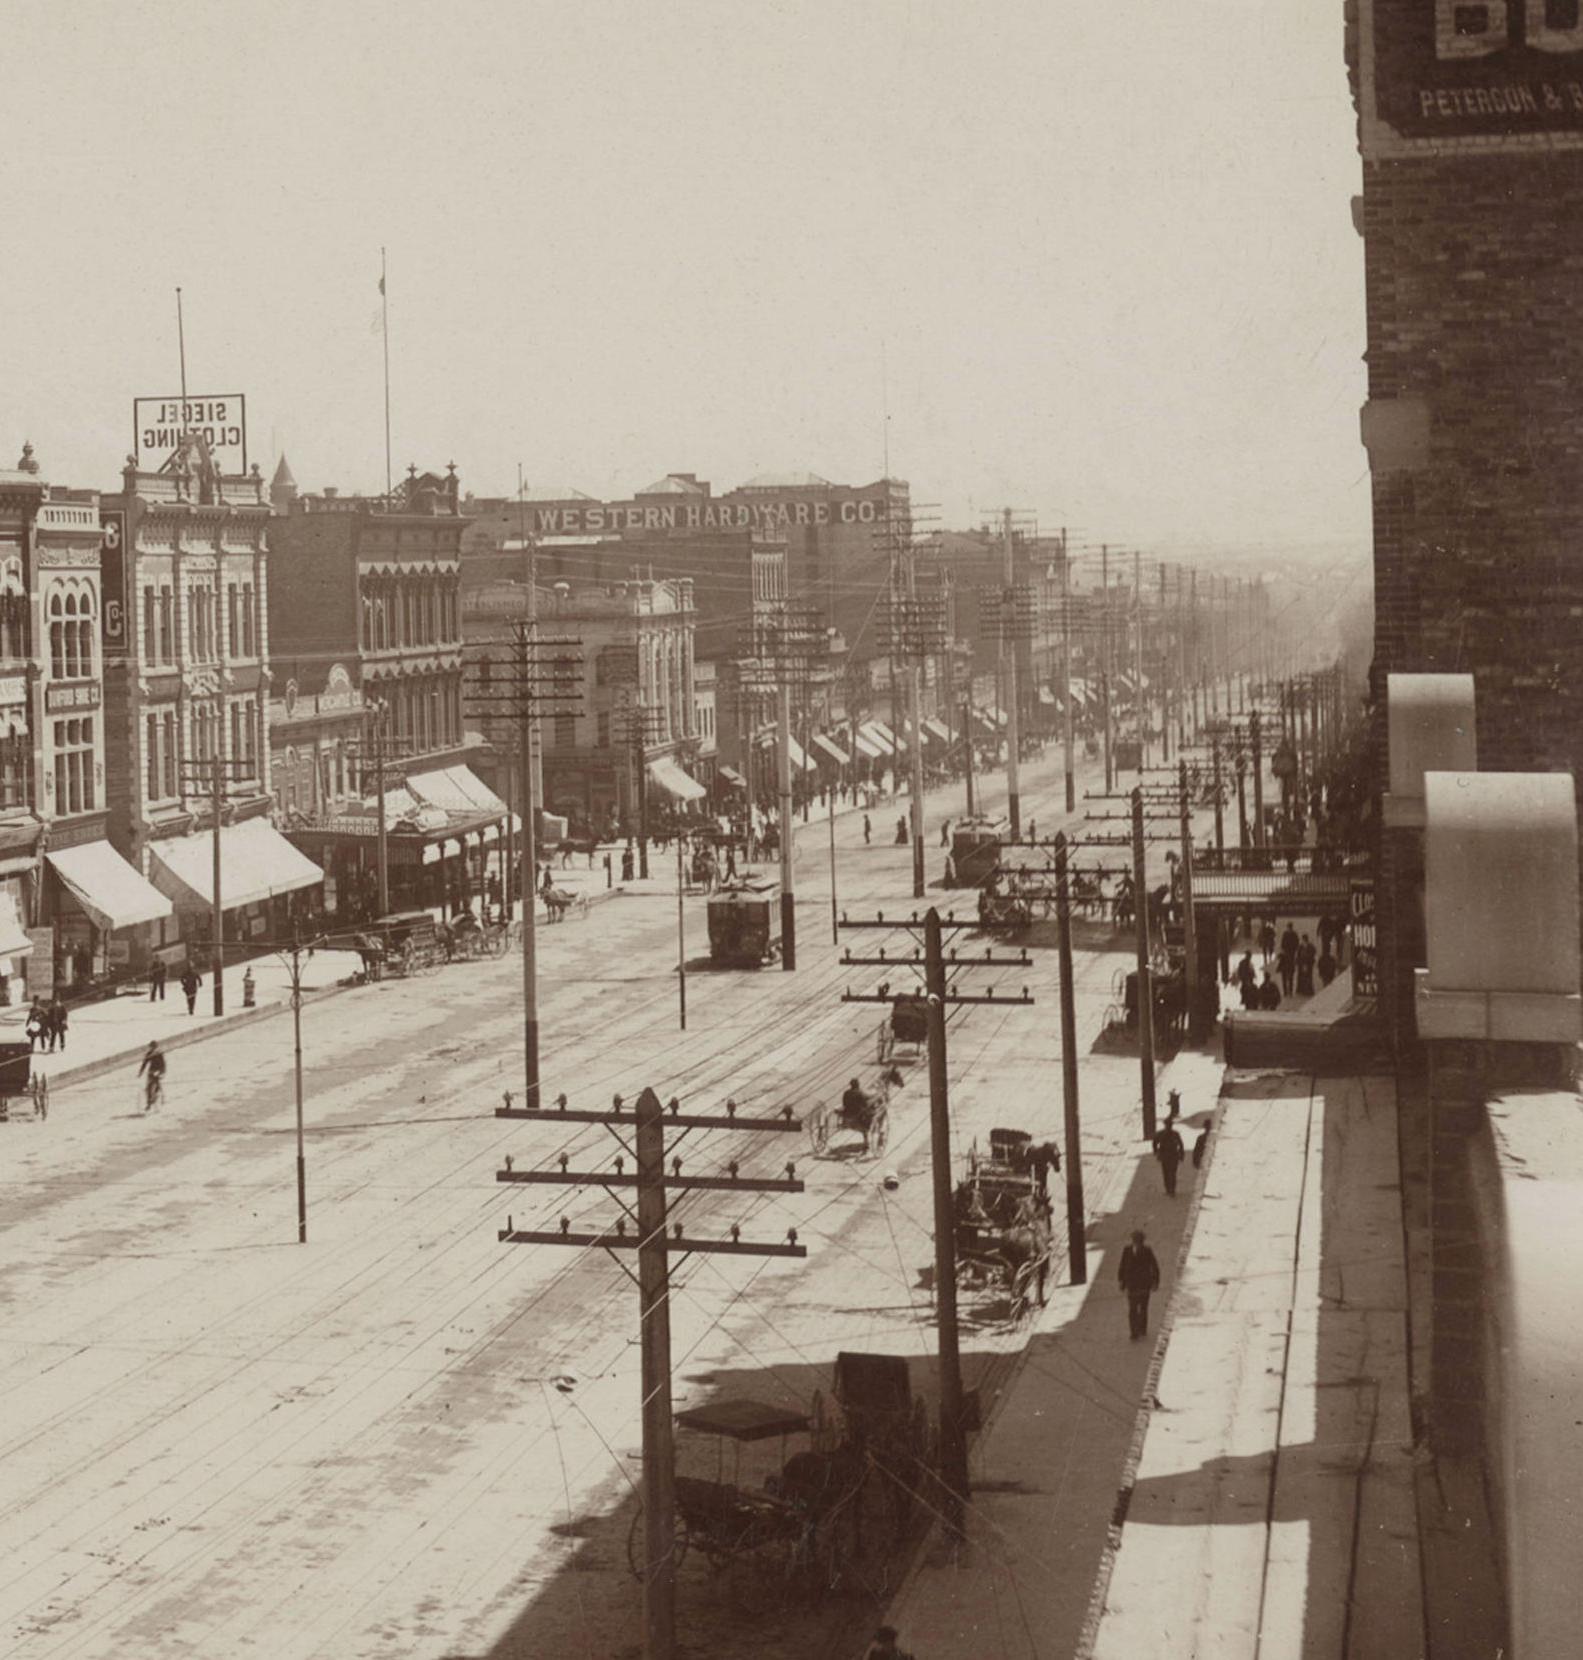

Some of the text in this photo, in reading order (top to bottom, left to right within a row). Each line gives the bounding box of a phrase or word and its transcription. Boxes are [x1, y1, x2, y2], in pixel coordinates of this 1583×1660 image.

[1543, 83, 1563, 110] &
[538, 506, 677, 531] WESTERN
[686, 503, 830, 528] HARDWARE
